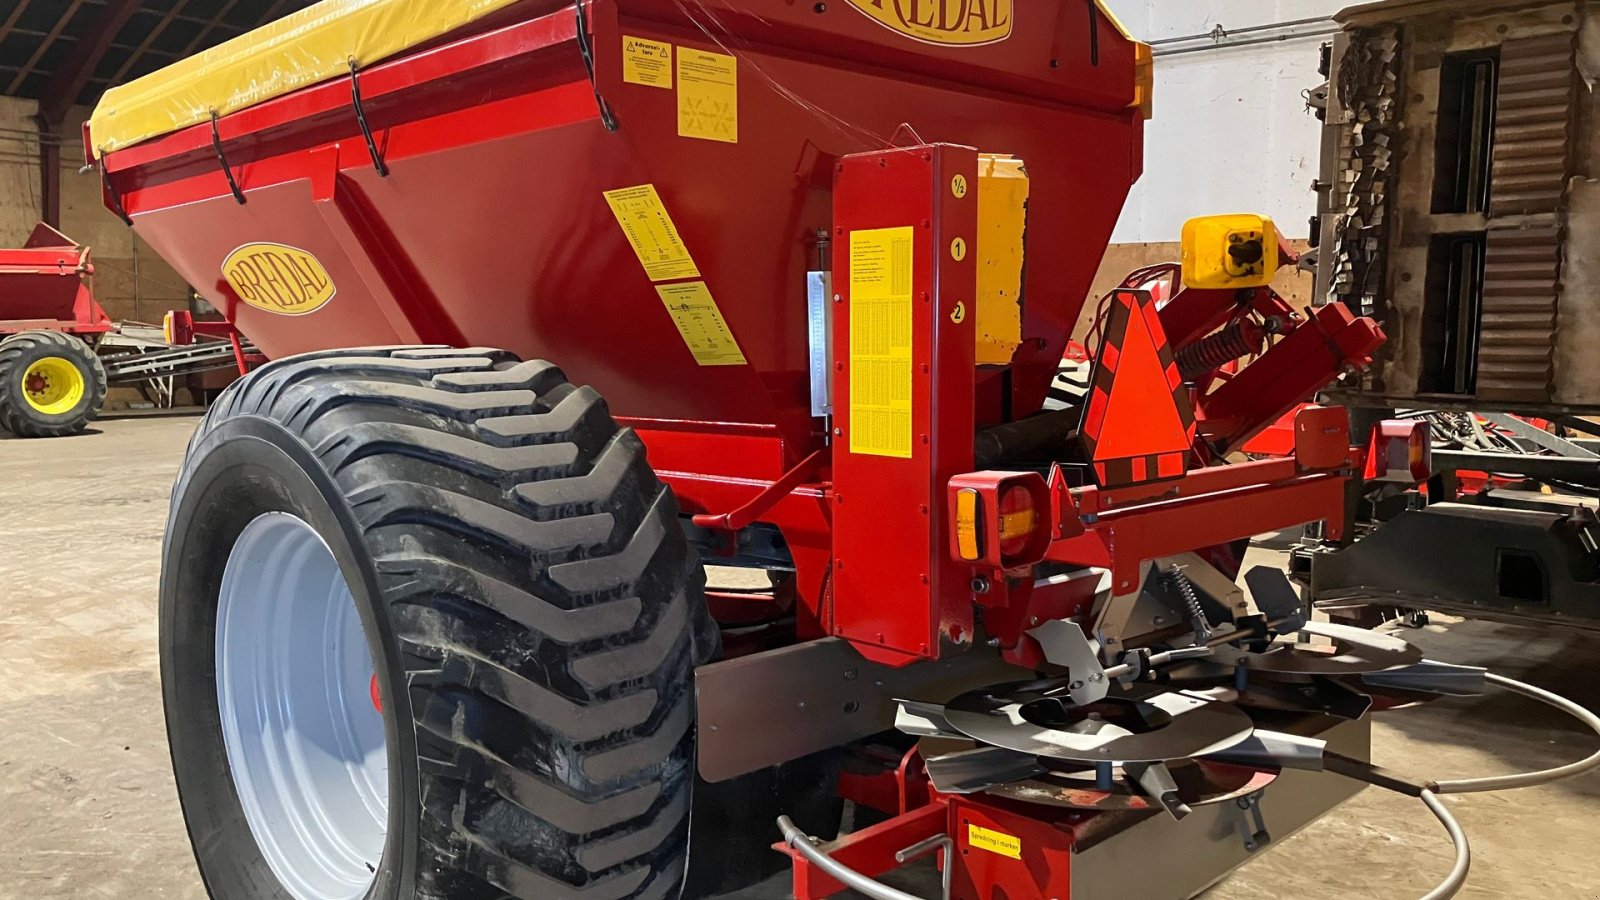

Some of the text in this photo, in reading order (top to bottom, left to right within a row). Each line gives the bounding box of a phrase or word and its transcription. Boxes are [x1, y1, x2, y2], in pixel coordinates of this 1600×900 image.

[955, 242, 961, 257] 1
[229, 252, 327, 310] BREDAL
[954, 304, 961, 320] 2
